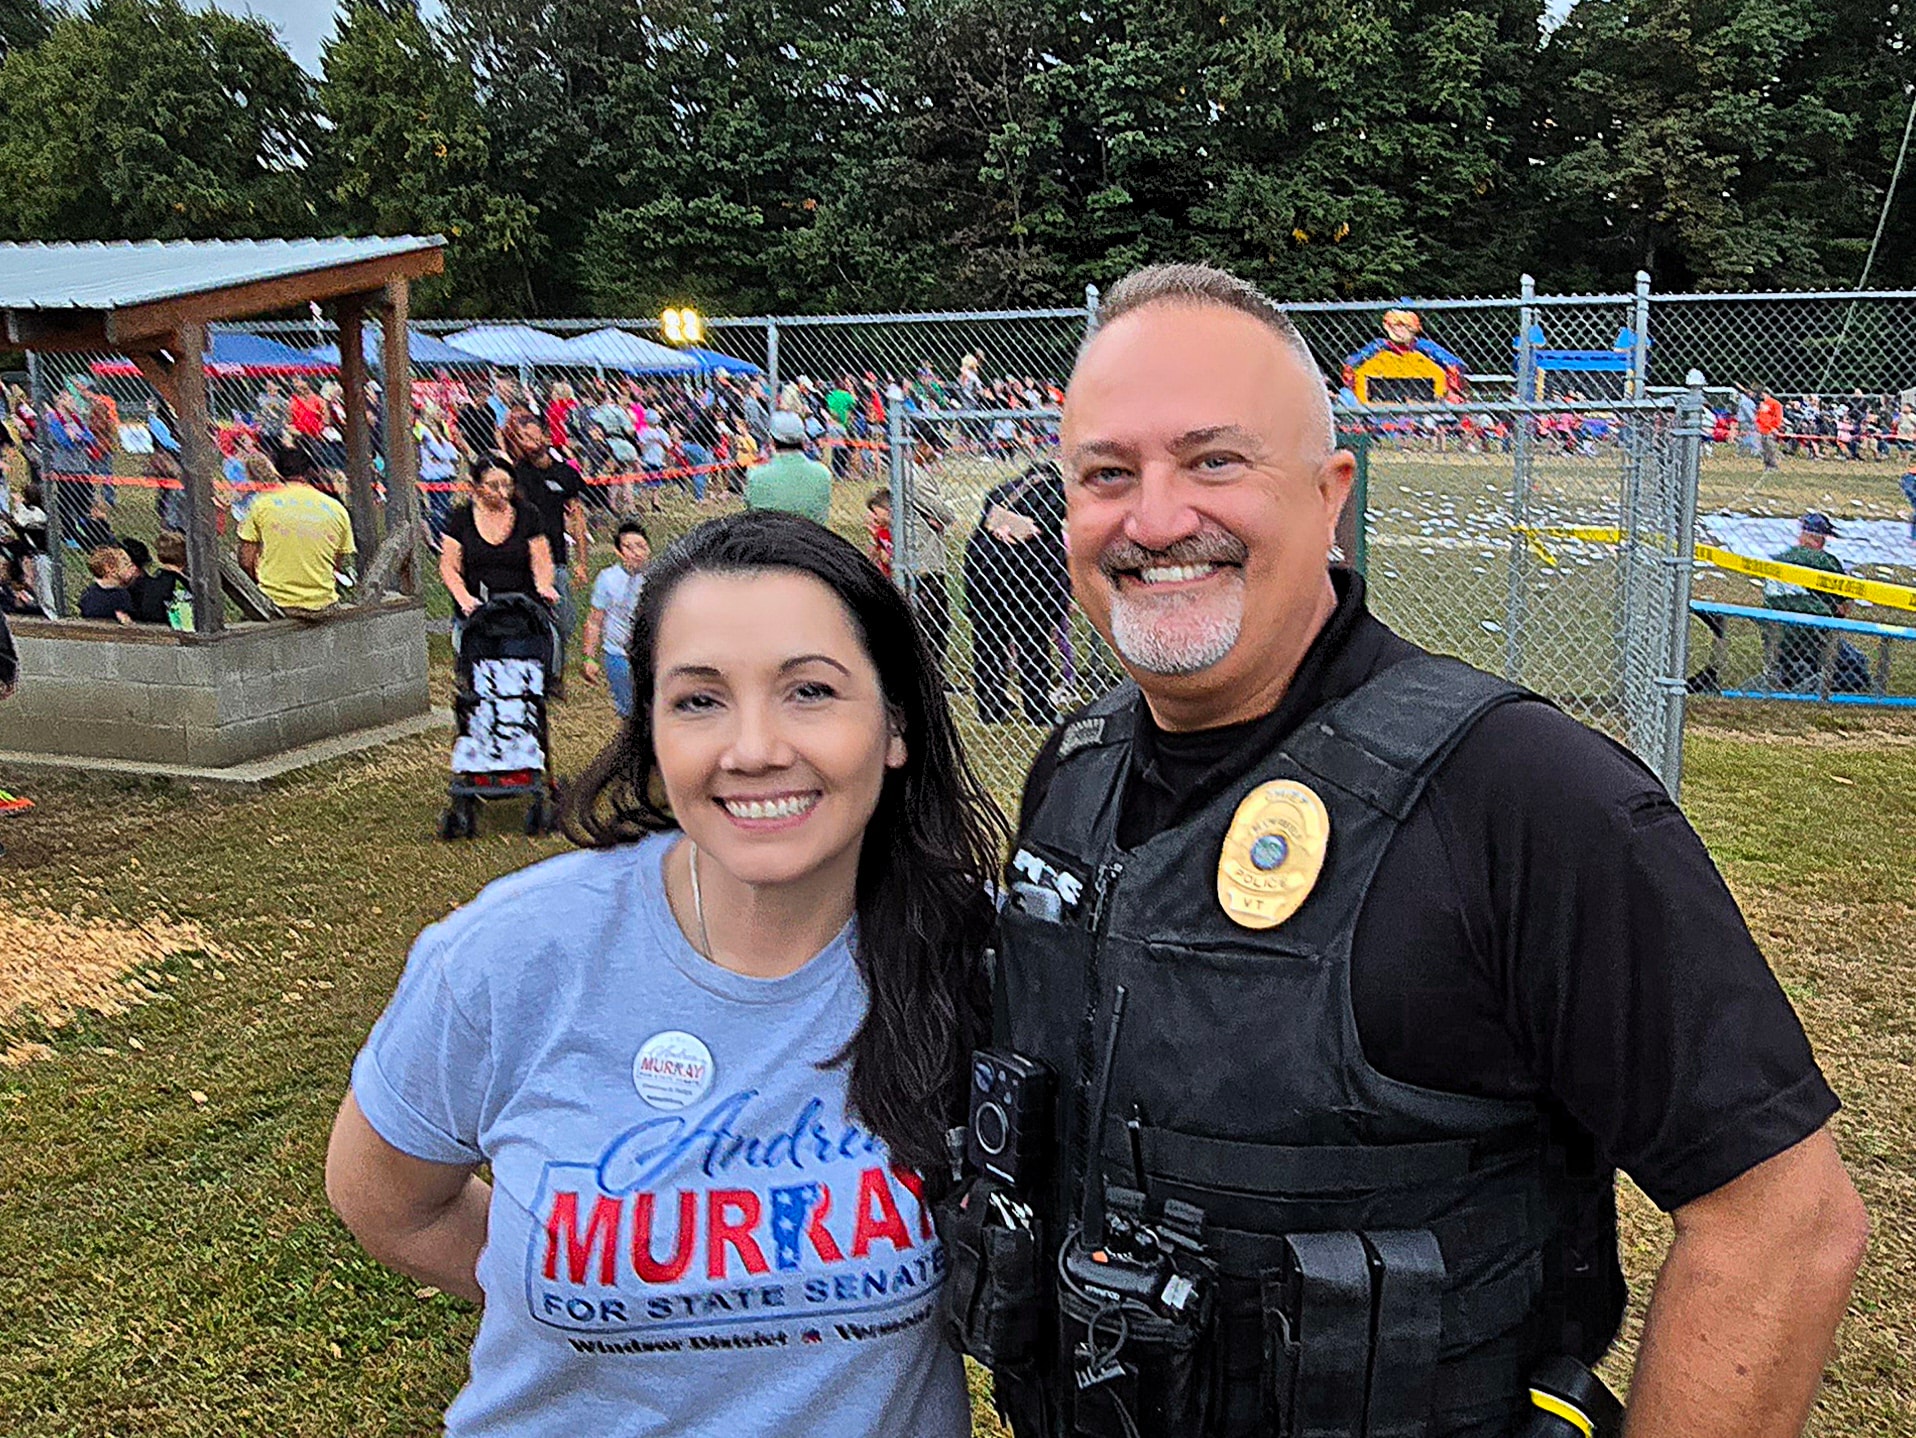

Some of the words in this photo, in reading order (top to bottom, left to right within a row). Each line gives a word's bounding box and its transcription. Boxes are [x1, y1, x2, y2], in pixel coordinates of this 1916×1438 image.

[1234, 868, 1288, 889] POLICE
[1242, 897, 1265, 911] VT
[640, 1056, 705, 1079] MURRAY
[541, 1164, 934, 1287] MURRAY
[543, 1291, 628, 1324] FOR
[646, 1283, 786, 1320] STATE
[804, 1249, 946, 1304] SENATE
